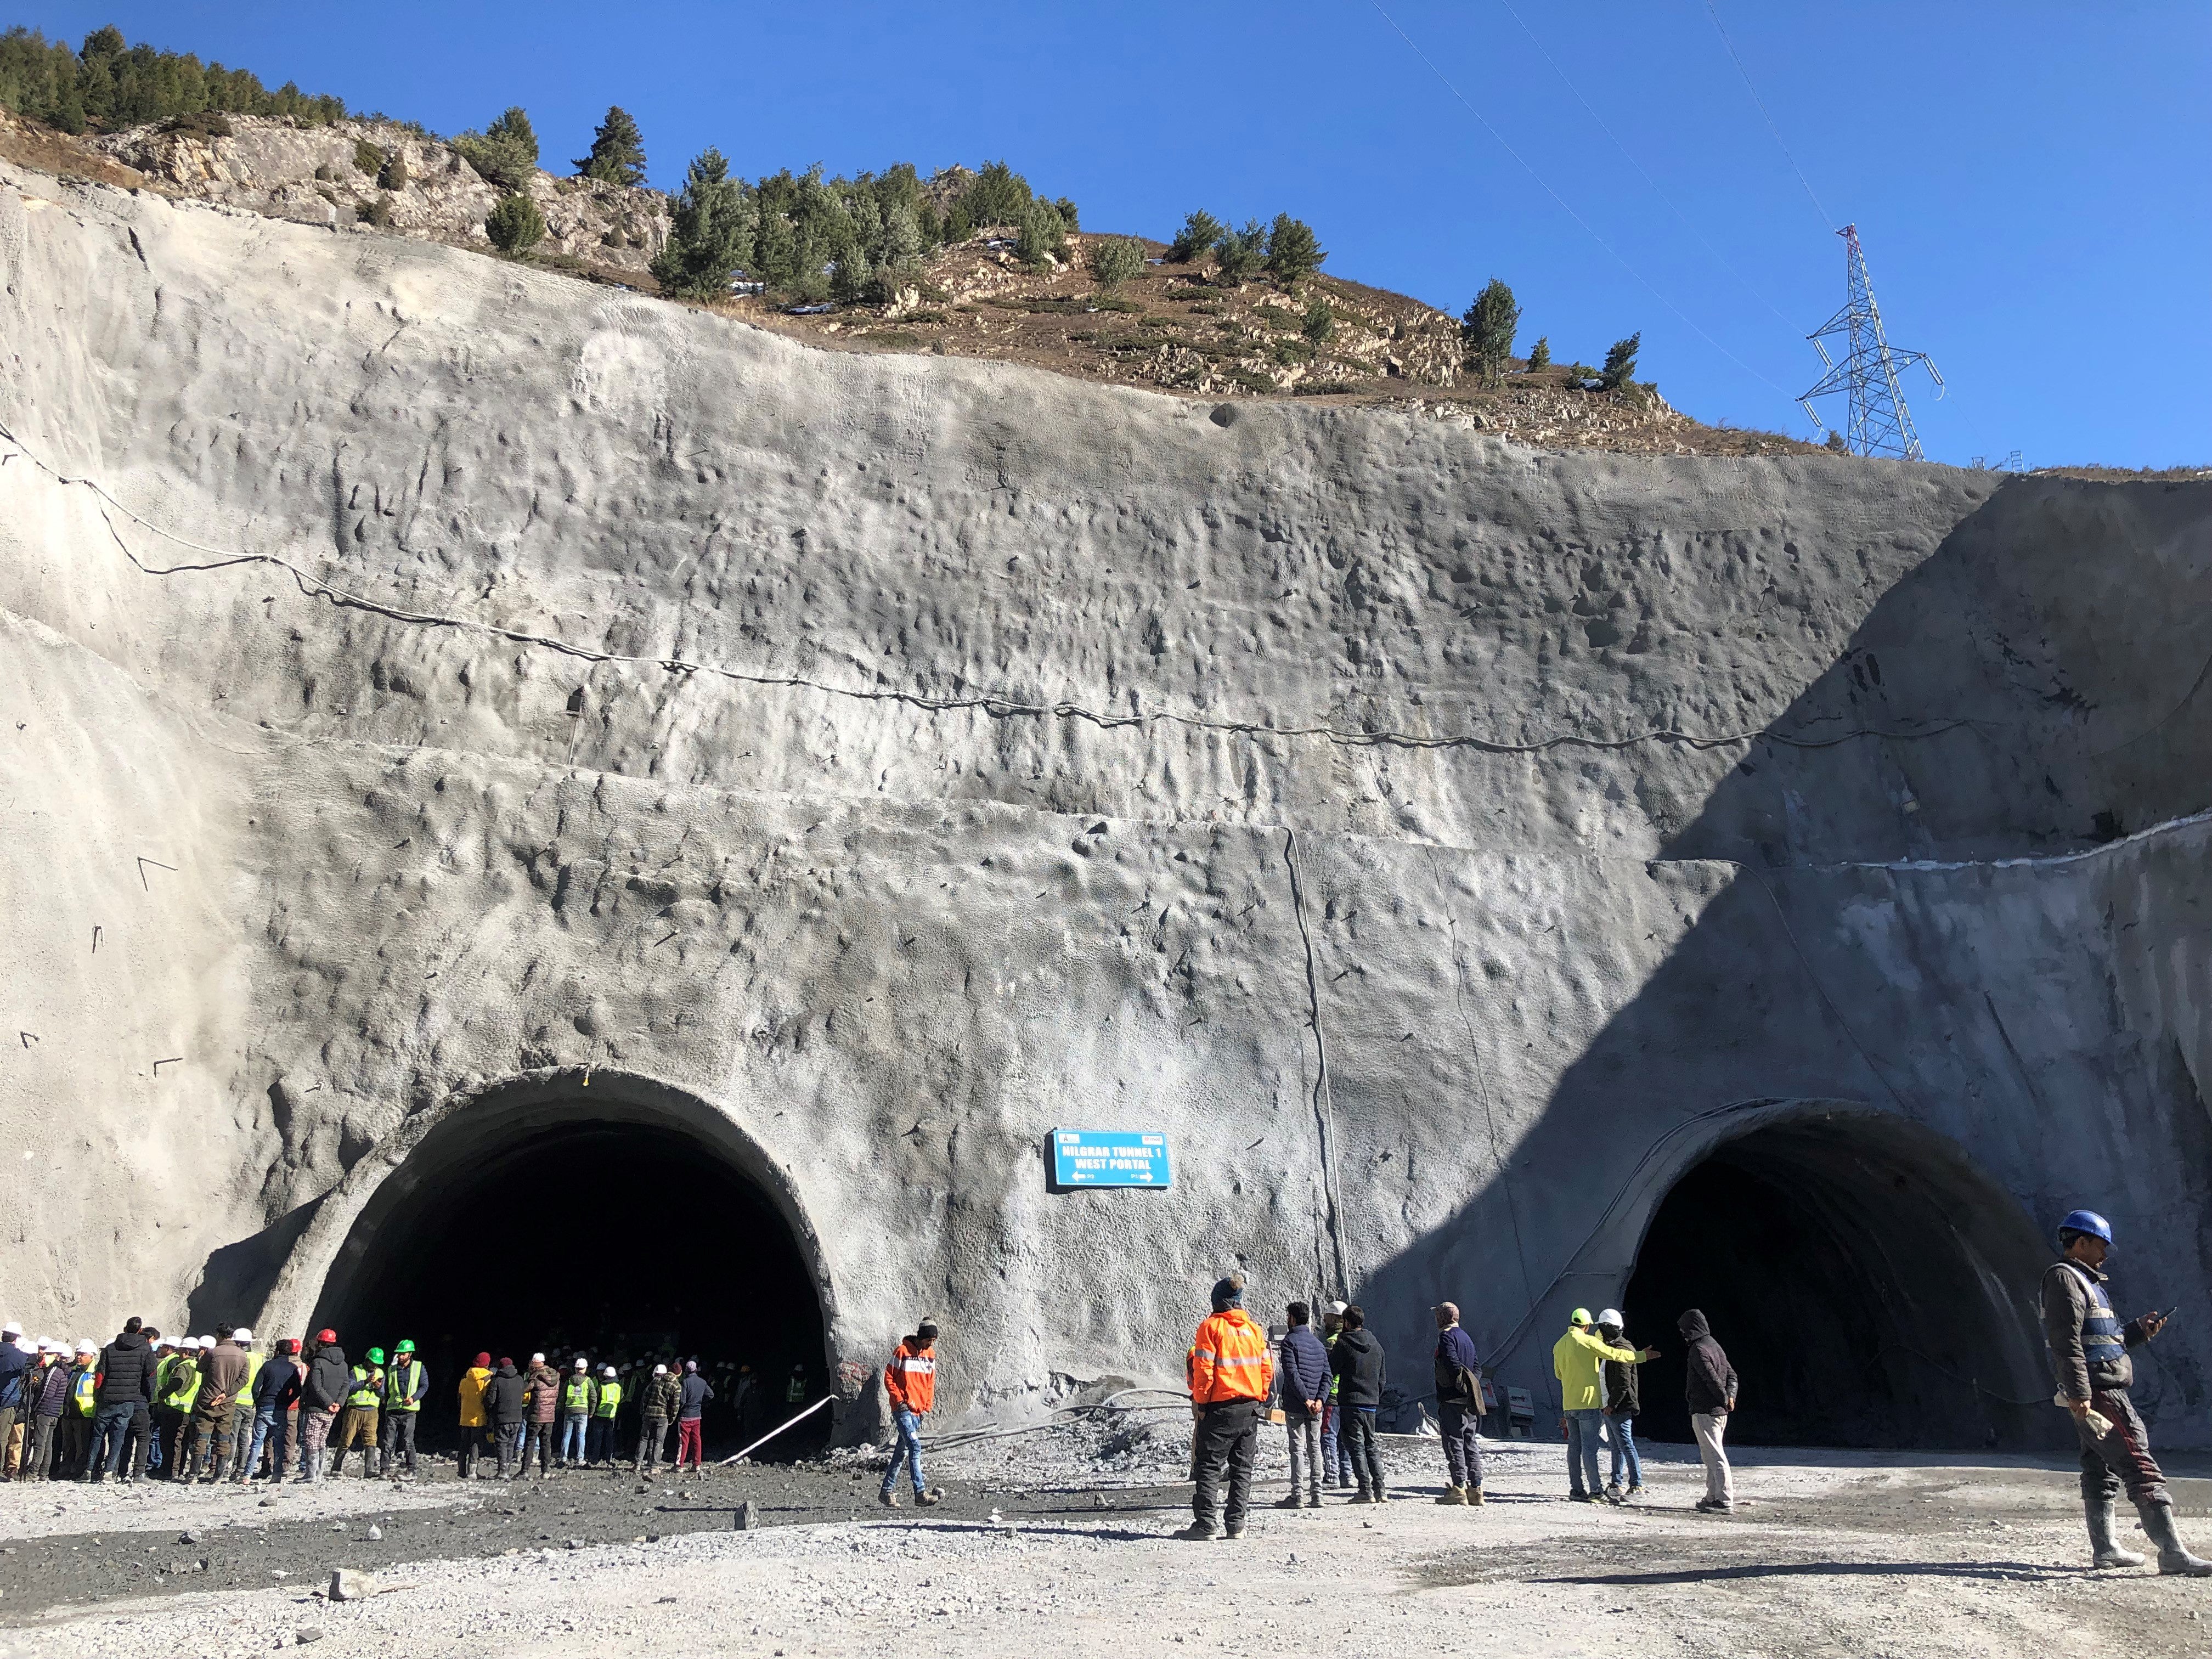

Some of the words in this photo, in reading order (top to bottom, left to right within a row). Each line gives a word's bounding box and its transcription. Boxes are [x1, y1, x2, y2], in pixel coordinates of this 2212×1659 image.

[1062, 1146, 1110, 1157] NILGRAR
[1112, 1147, 1154, 1158] TUNNEL
[1155, 1147, 1161, 1158] 1
[1075, 1158, 1107, 1169] WEST
[1109, 1159, 1151, 1170] PORTAL
